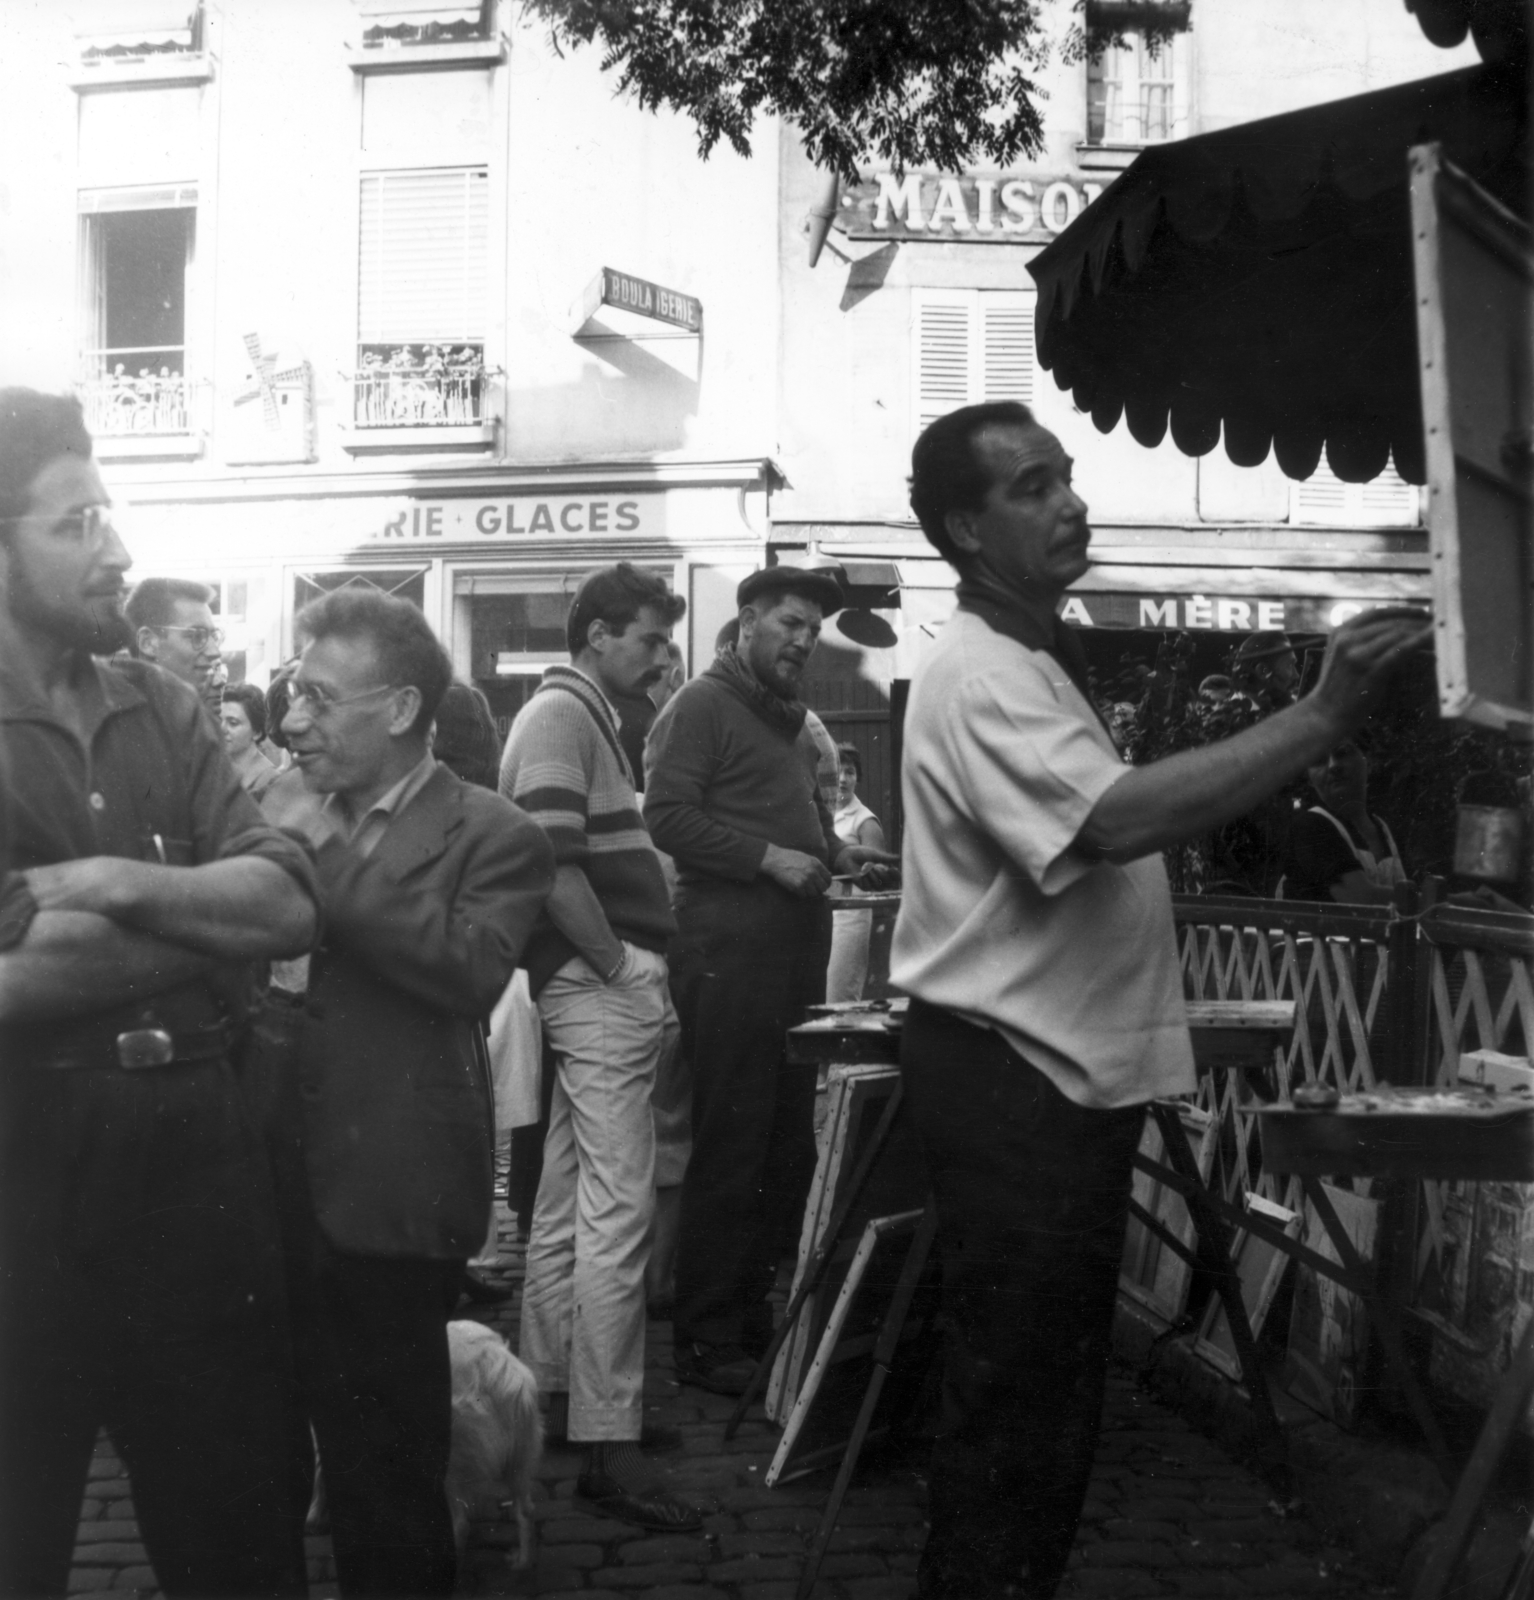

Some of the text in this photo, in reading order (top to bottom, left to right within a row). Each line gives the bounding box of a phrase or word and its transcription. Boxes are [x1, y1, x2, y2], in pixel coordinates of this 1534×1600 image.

[872, 172, 1103, 233] MAISO
[371, 501, 641, 538] RIE GLACES
[1139, 594, 1285, 630] MÈRE
